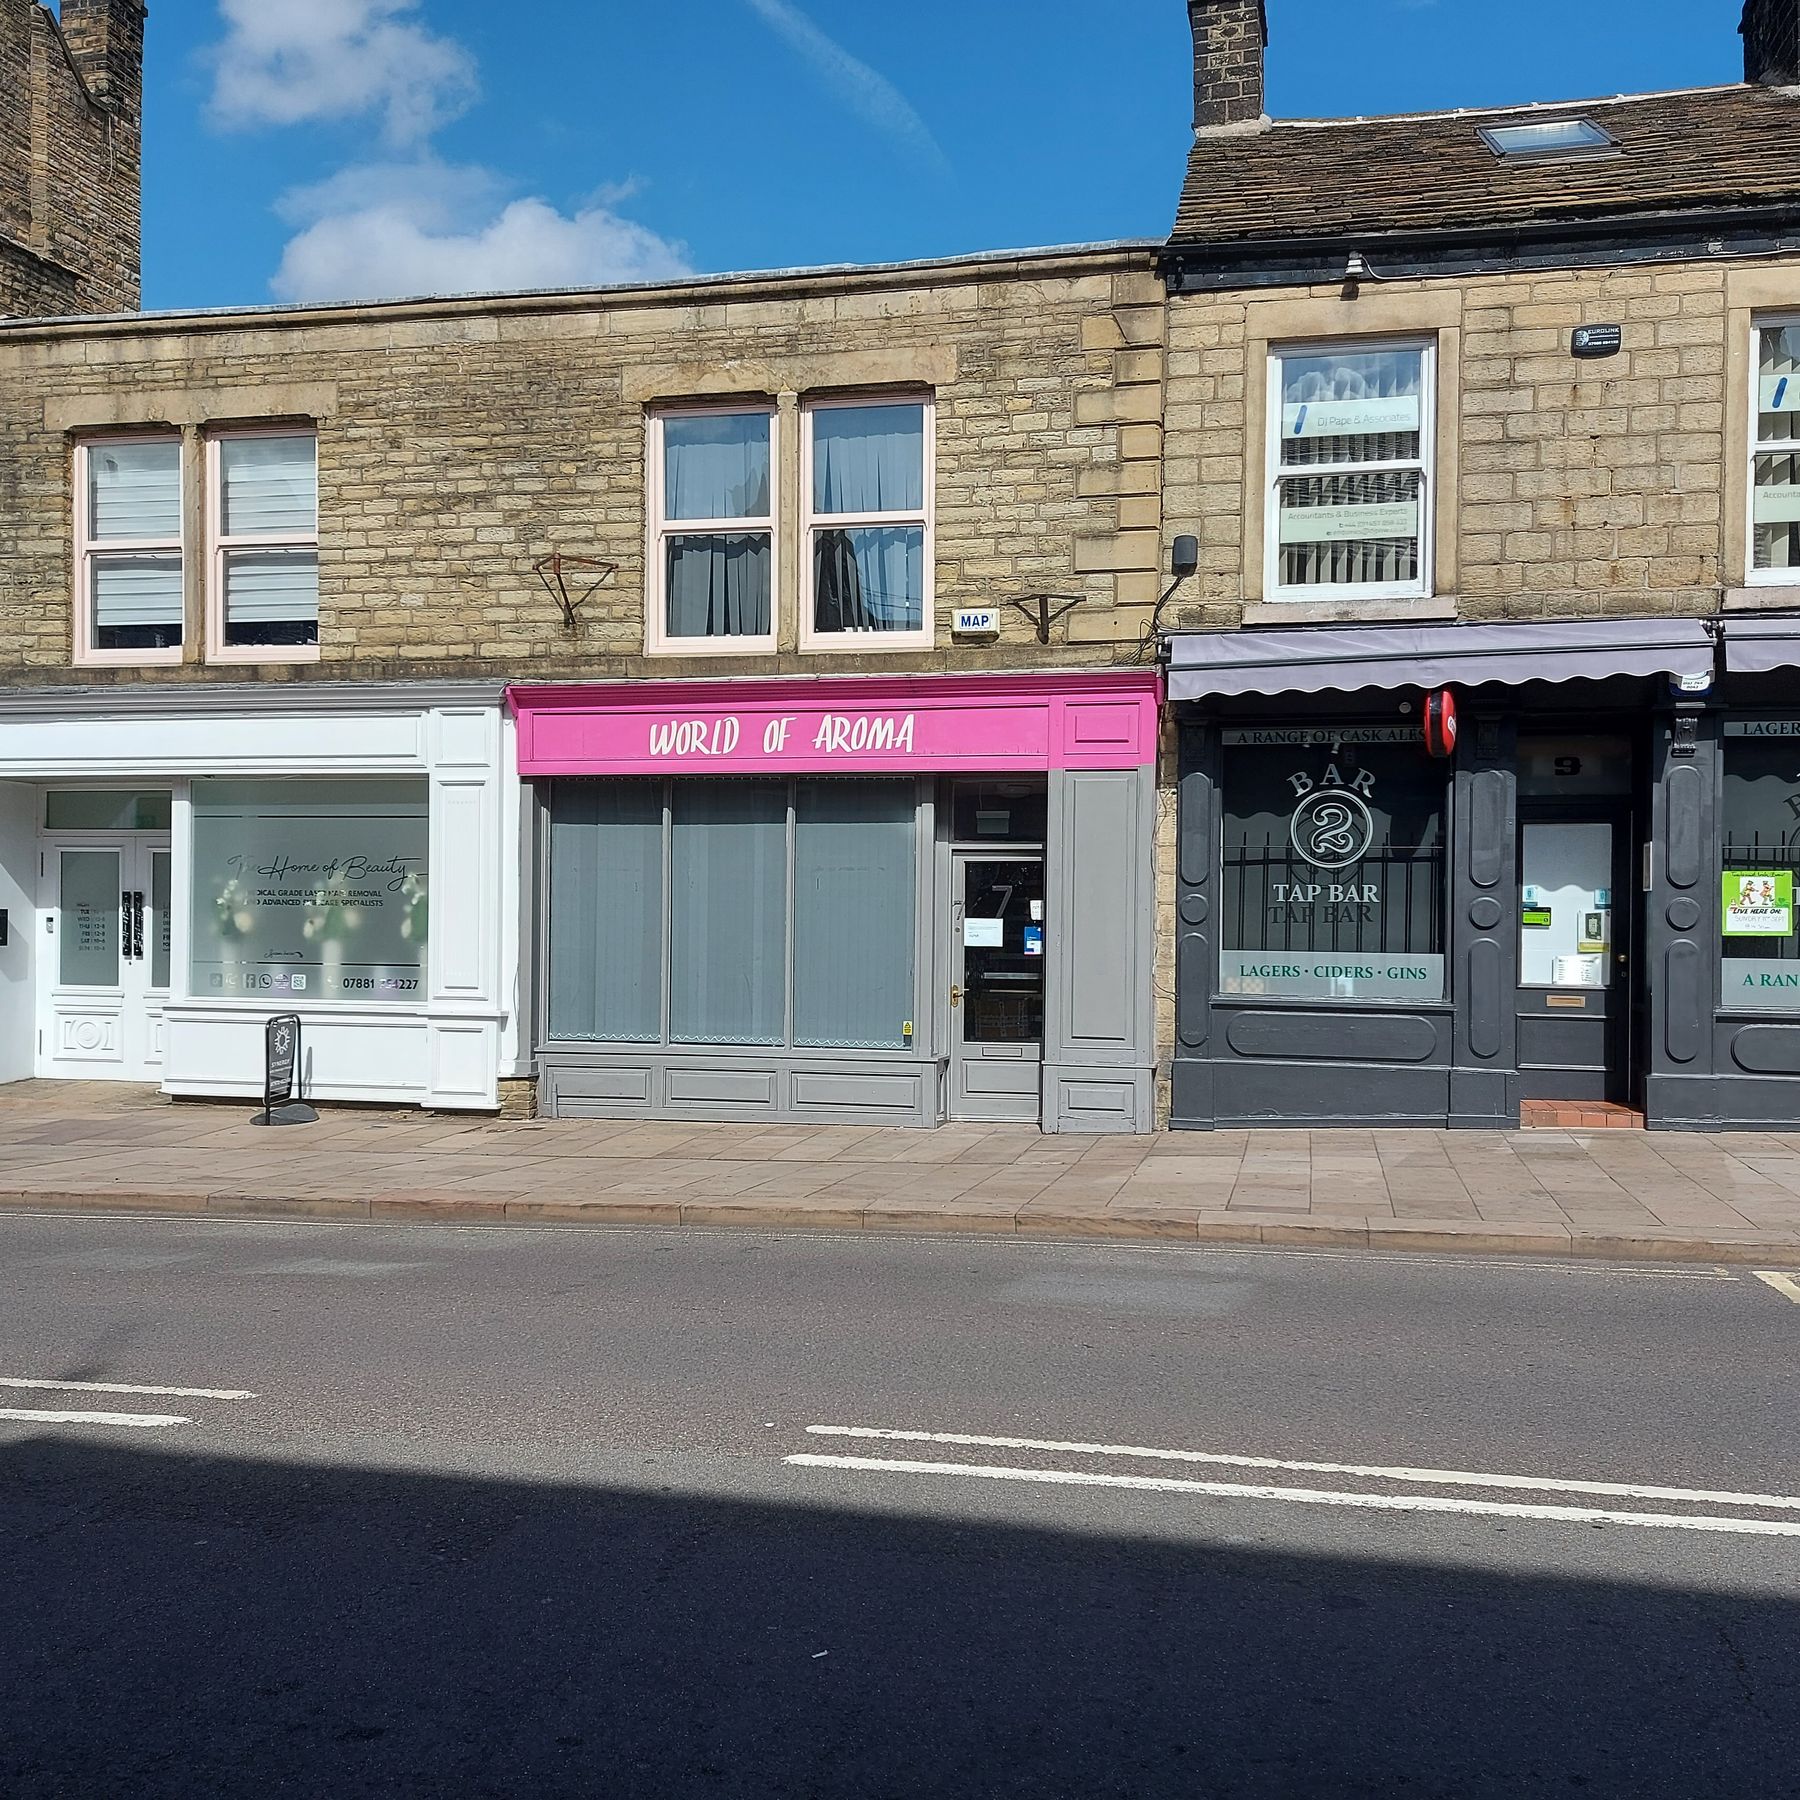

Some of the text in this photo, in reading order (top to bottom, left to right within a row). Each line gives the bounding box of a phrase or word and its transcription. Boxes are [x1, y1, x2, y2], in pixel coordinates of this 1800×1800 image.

[1330, 416, 1351, 427] Pape
[1363, 413, 1411, 424] Associates
[1288, 511, 1334, 520] Accountants
[1344, 510, 1378, 518] Business
[1379, 508, 1408, 517] Experts
[961, 615, 989, 627] MAP
[650, 714, 915, 755] WORLD OF AROMA
[1237, 732, 1249, 743] A
[1252, 731, 1308, 743] RANGE
[1313, 730, 1336, 742] OF
[1340, 730, 1383, 742] CASK
[1554, 757, 1582, 776] 9
[1286, 764, 1376, 798] BAR
[257, 855, 320, 881] Home
[322, 858, 339, 879] of
[339, 855, 428, 892] Beauty
[278, 889, 303, 897] GRADE
[1273, 884, 1380, 903] TAP BAR
[341, 899, 384, 907] SPECIALISTS
[992, 885, 1013, 919] 7
[1240, 965, 1427, 979] LAGERS CIDERS GINS
[343, 978, 374, 989] 07881
[1742, 973, 1798, 987] A RAN
